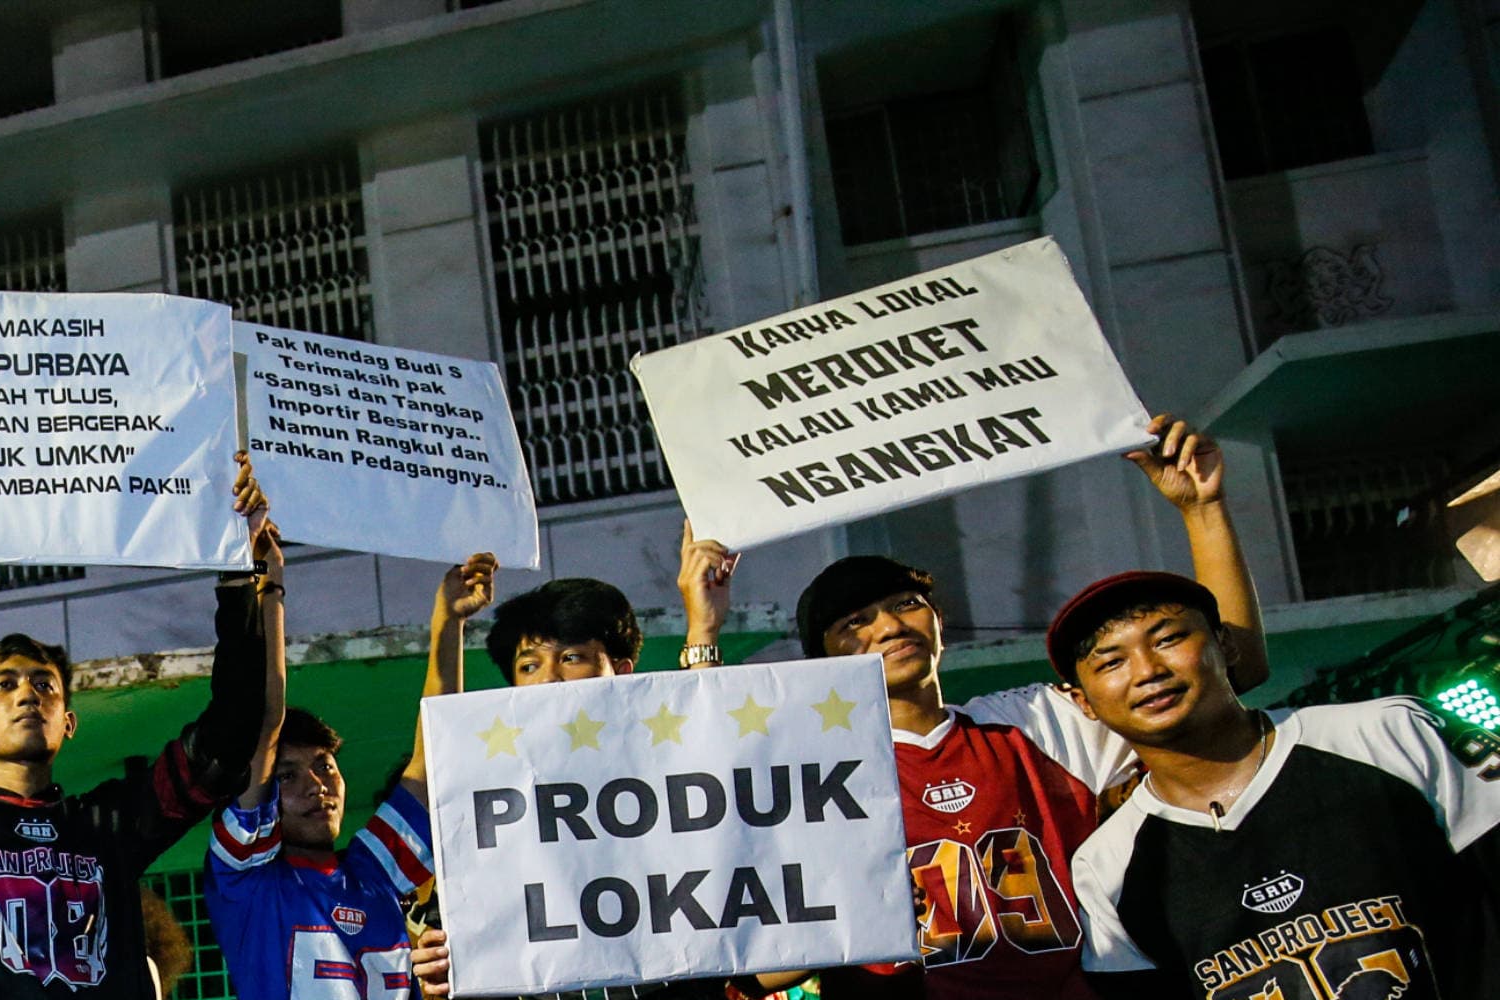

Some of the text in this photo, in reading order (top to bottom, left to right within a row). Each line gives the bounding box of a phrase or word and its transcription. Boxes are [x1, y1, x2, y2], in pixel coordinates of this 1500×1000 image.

[725, 277, 979, 359] KARYA LOKAL
[256, 331, 462, 379] Pak Mendag Budi S
[278, 354, 446, 397] Terimaksih pak
[740, 318, 988, 410] MEROKET
[34, 387, 118, 408] TULUS,
[268, 393, 480, 440] Importir Besarnya..
[348, 387, 387, 406] dan
[391, 394, 484, 424] Tangkap
[727, 355, 1059, 458] KALAU KAMU MAU
[37, 414, 176, 434] BERGERAK..
[269, 415, 489, 463] Namun Rangkul dan
[251, 438, 508, 489] arahkan Pedagangnya..
[758, 407, 1052, 507] NGANGKAT
[128, 476, 196, 496] PAK!!!
[473, 759, 869, 849] PRODUK
[524, 863, 836, 943] LOKAL
[1194, 895, 1405, 991] SAN PROJECT
